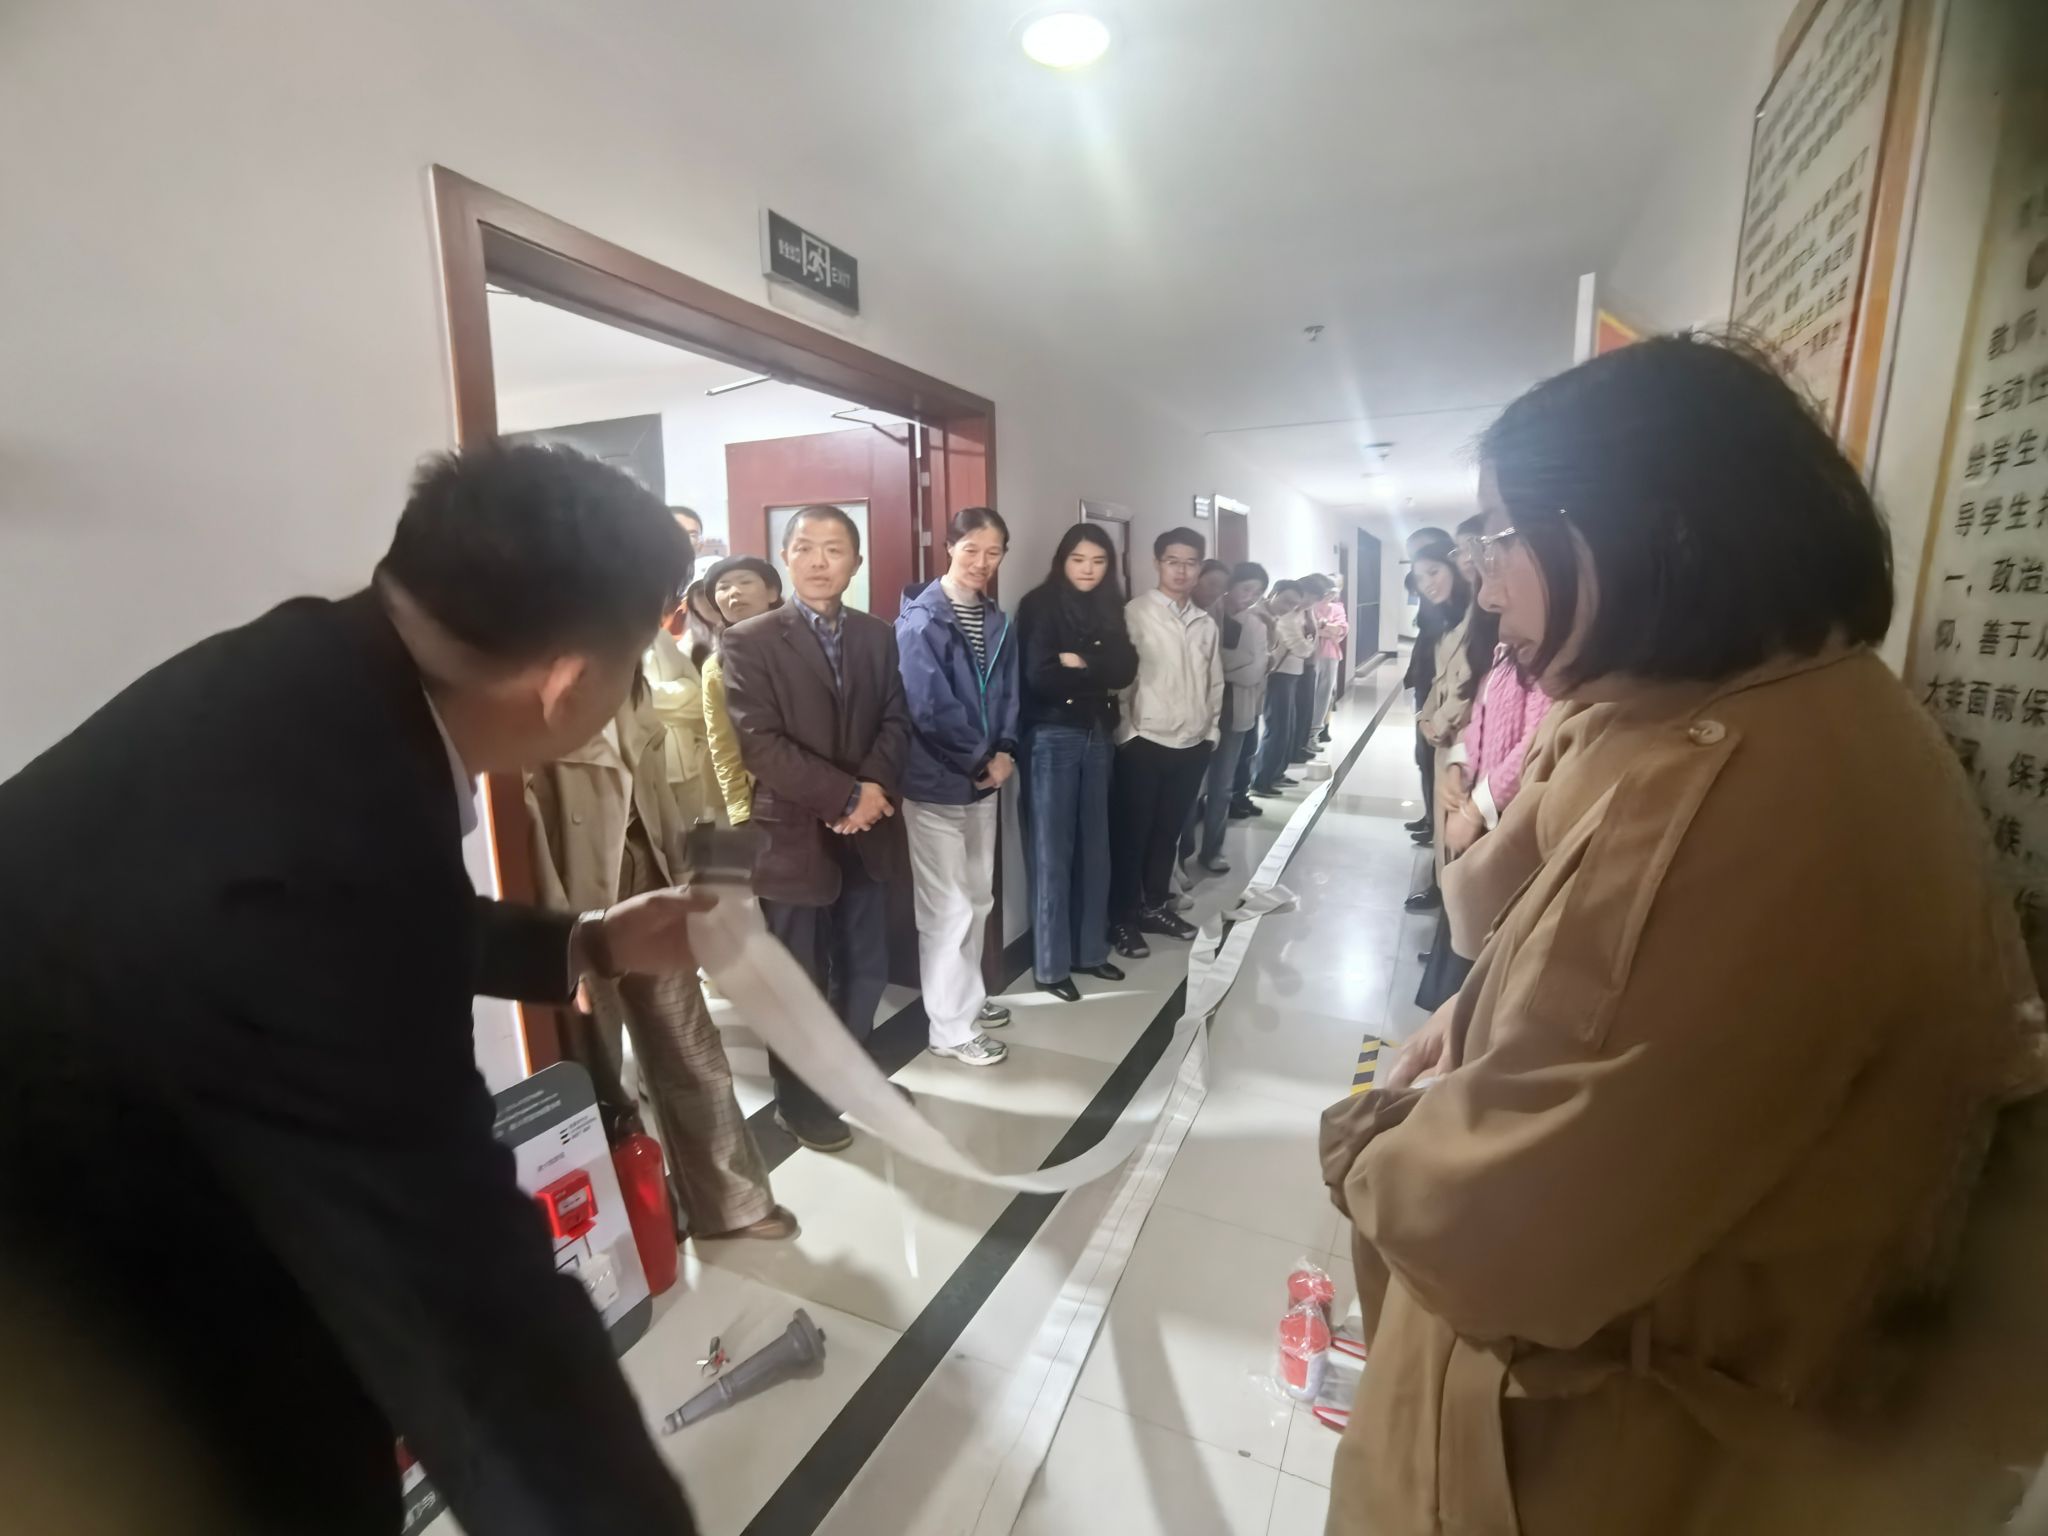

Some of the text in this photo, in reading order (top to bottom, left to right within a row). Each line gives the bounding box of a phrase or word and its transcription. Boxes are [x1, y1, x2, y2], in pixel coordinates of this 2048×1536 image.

[1964, 428, 2048, 479] 学生
[1945, 557, 2048, 597] 一，政治
